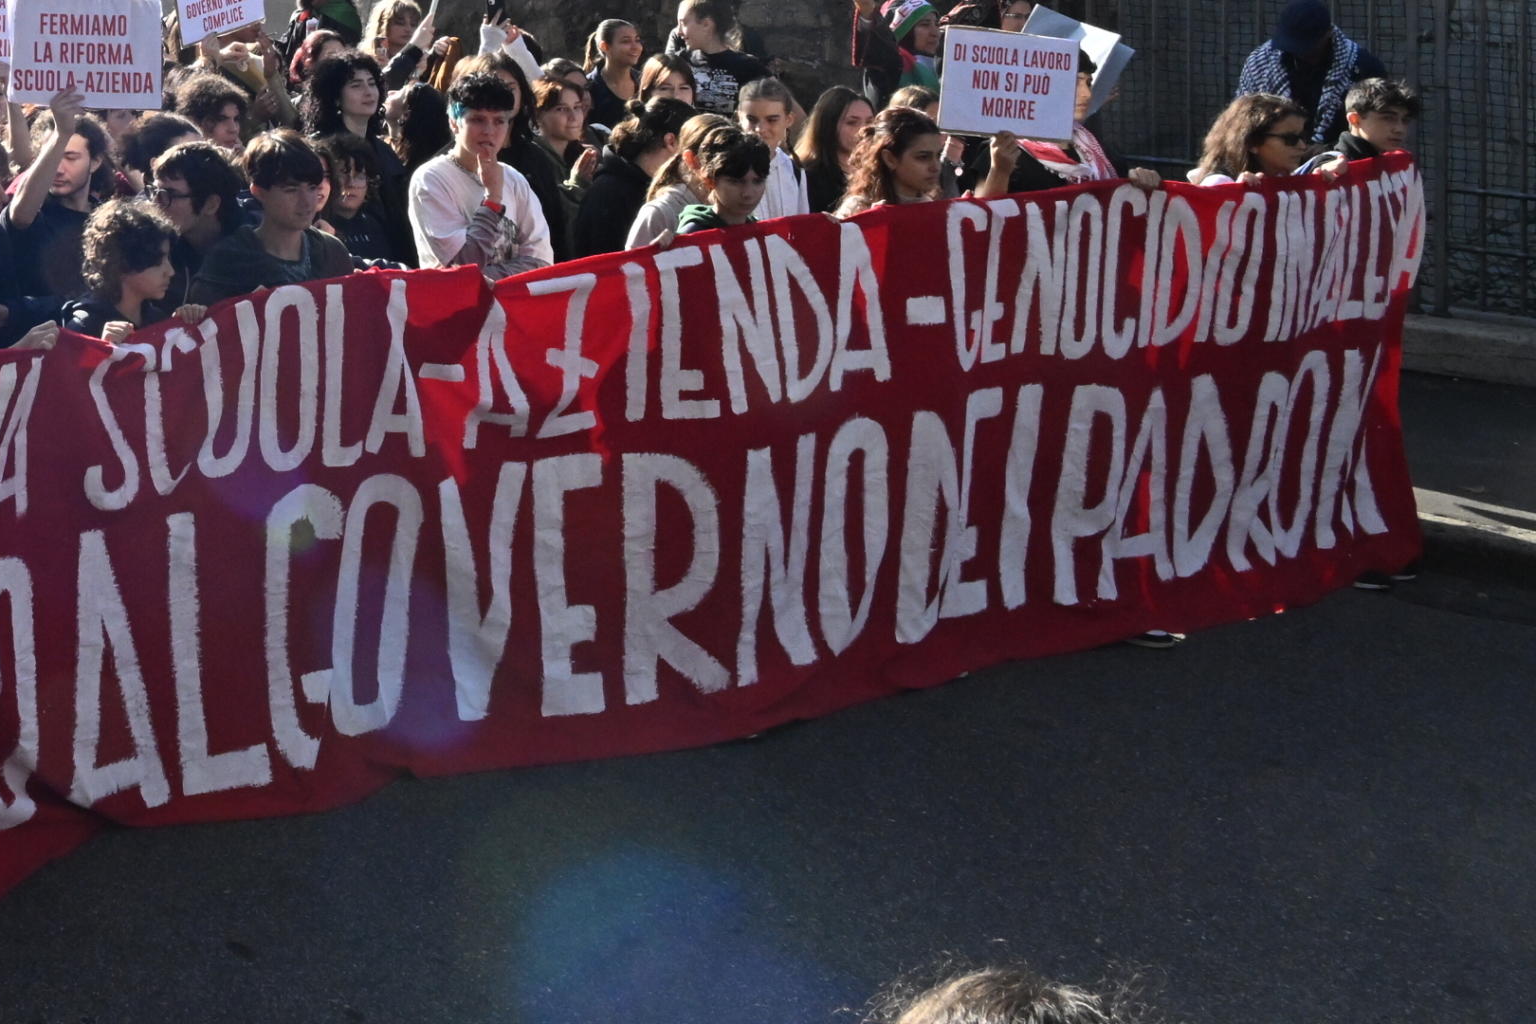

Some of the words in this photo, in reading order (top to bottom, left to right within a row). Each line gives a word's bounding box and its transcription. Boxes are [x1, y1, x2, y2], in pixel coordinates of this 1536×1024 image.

[40, 14, 127, 36] FERMIAMO
[203, 6, 244, 32] COMPLICE
[34, 42, 53, 63] LA
[60, 43, 133, 64] RIFORMA
[954, 43, 967, 62] DI
[972, 45, 1019, 67] SCUOLA
[1024, 49, 1072, 71] LAVORO
[14, 69, 154, 93] SCUOLA-AZIENDA
[972, 69, 999, 91] NON
[1005, 72, 1018, 92] SI
[1024, 73, 1051, 95] PUÒ
[982, 97, 1036, 120] MORIRE
[947, 183, 1266, 372] GENOCIDIO
[70, 512, 272, 808] AL
[265, 414, 889, 770] GOVERNO
[896, 383, 1044, 644] DEI
